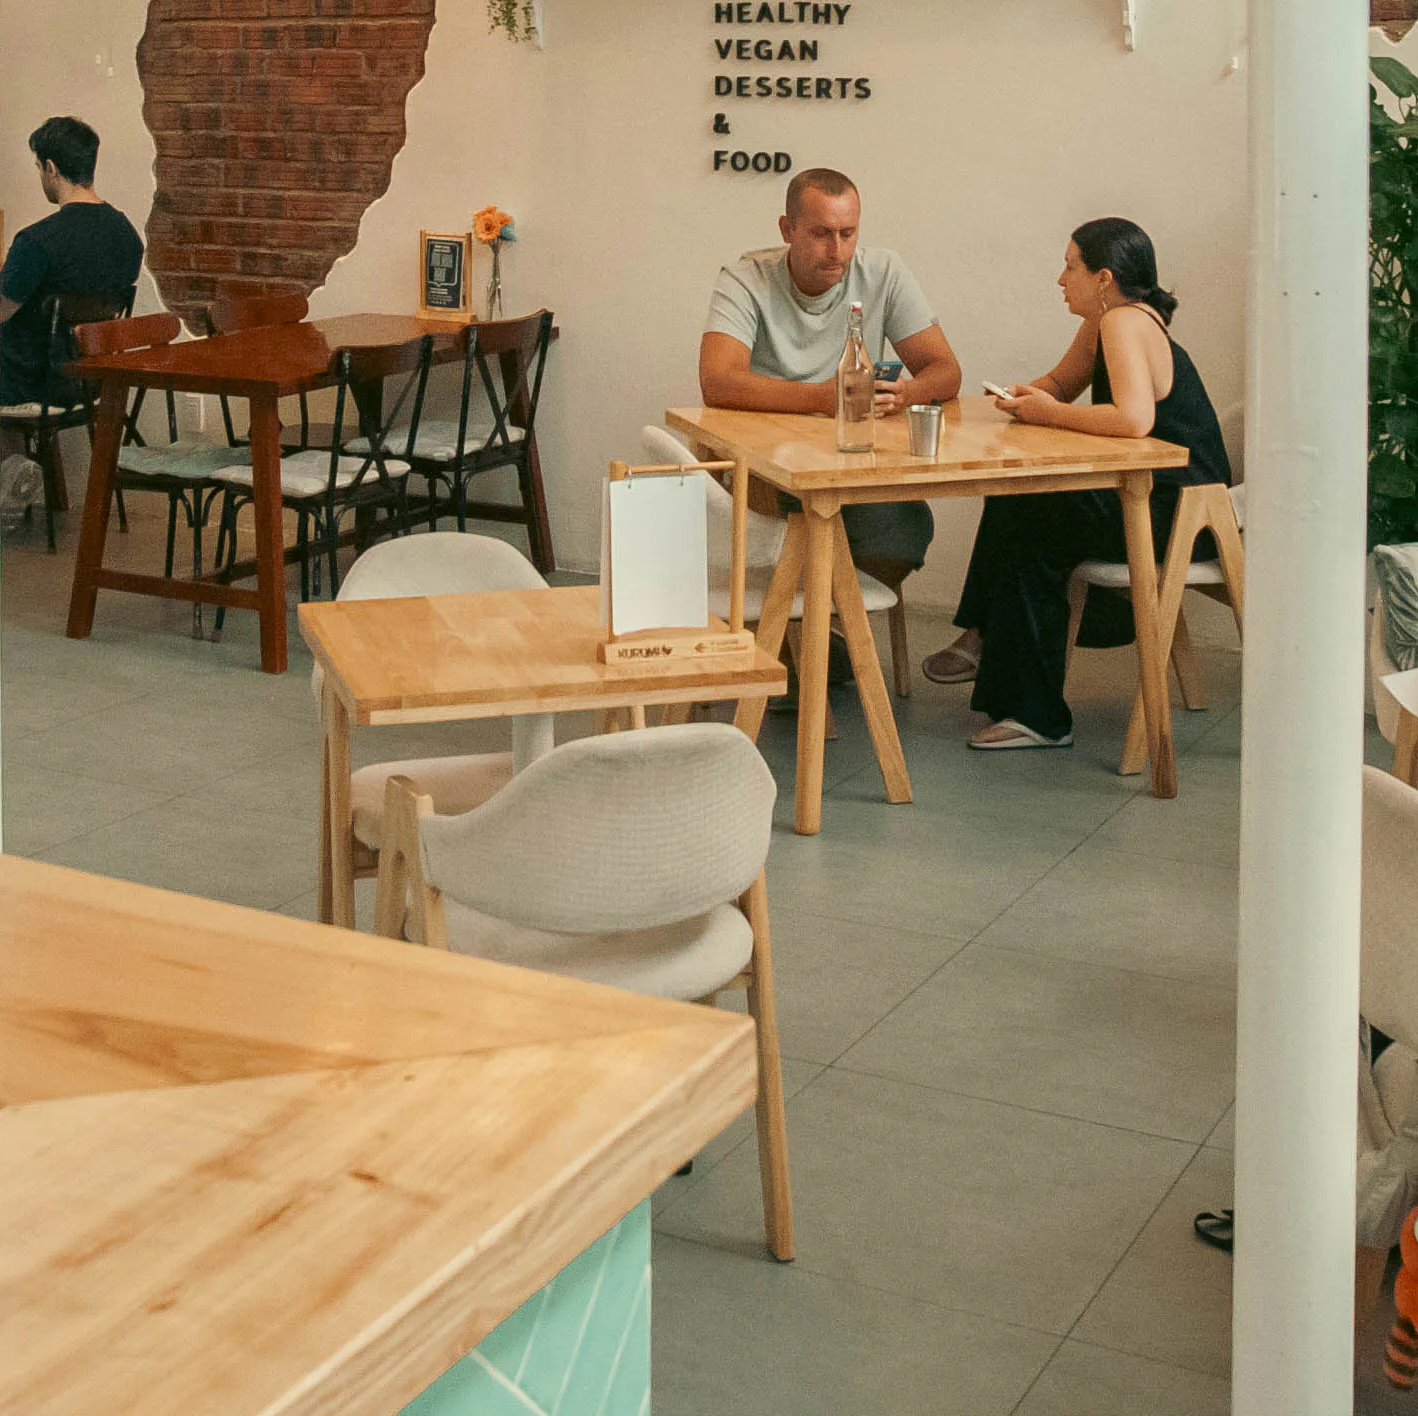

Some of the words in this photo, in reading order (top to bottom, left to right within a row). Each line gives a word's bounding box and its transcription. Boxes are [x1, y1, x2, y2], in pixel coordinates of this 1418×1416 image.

[714, 2, 851, 25] HEALTHY
[714, 39, 818, 61] VEGAN
[714, 76, 871, 99] DESSERTS
[713, 113, 731, 134] &
[713, 150, 792, 173] FOOD
